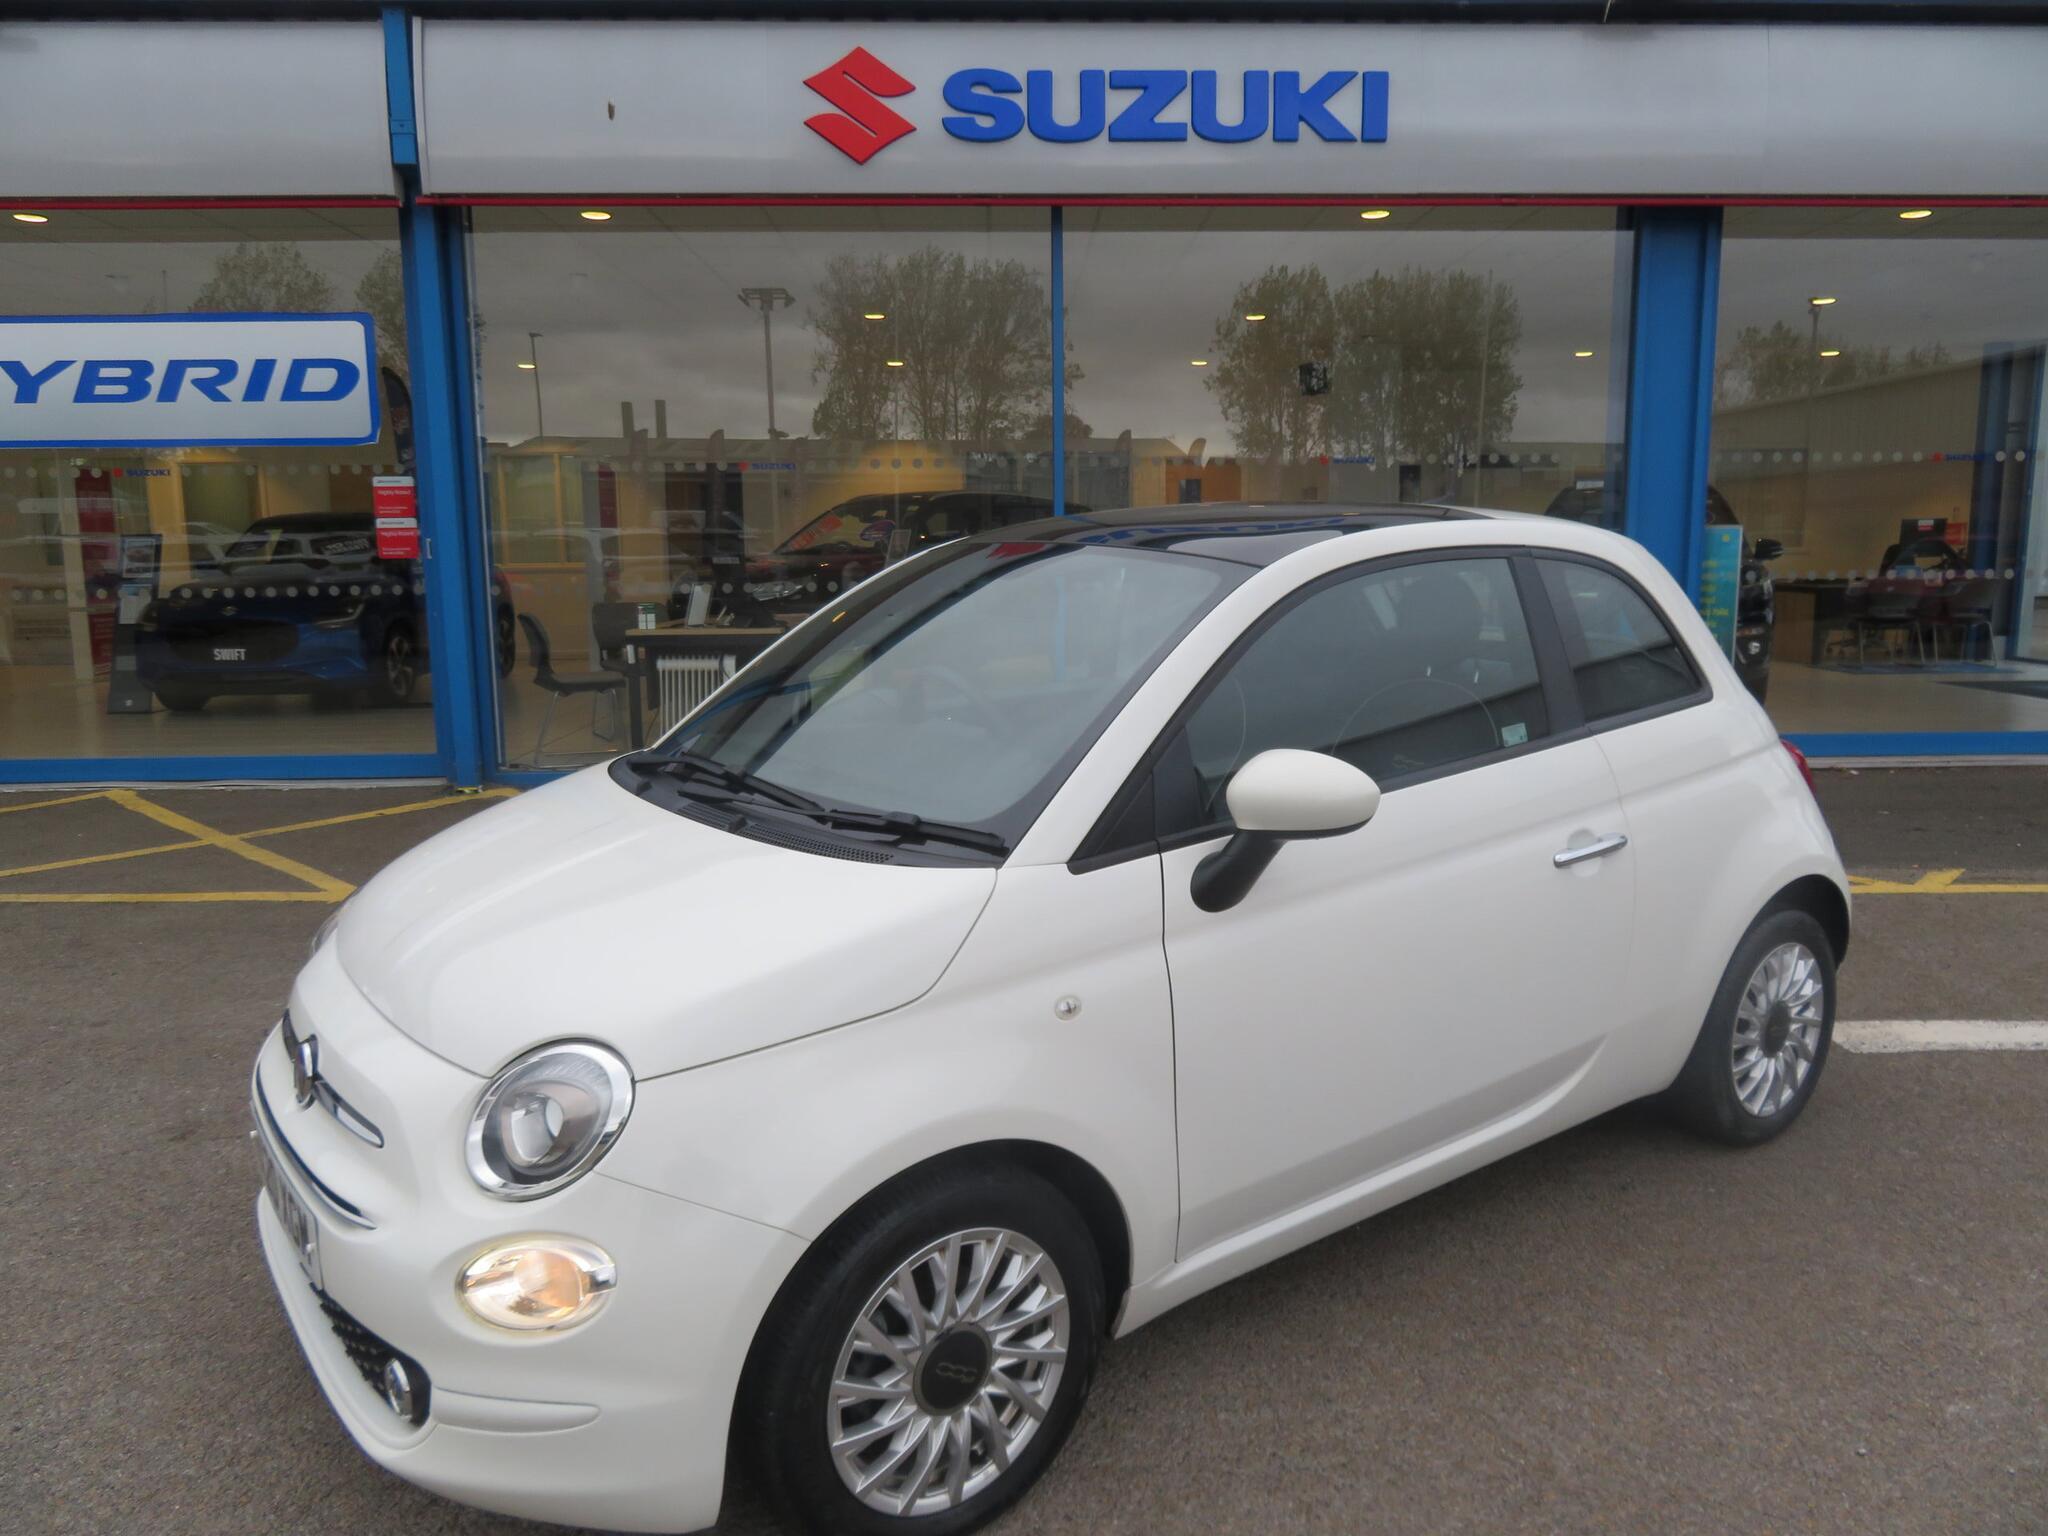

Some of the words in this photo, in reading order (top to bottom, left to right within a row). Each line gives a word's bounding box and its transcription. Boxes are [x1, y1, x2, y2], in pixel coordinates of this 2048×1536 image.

[942, 68, 1389, 143] SUZUKI
[126, 469, 171, 477] SUZUKI
[213, 648, 247, 661] SWIFT
